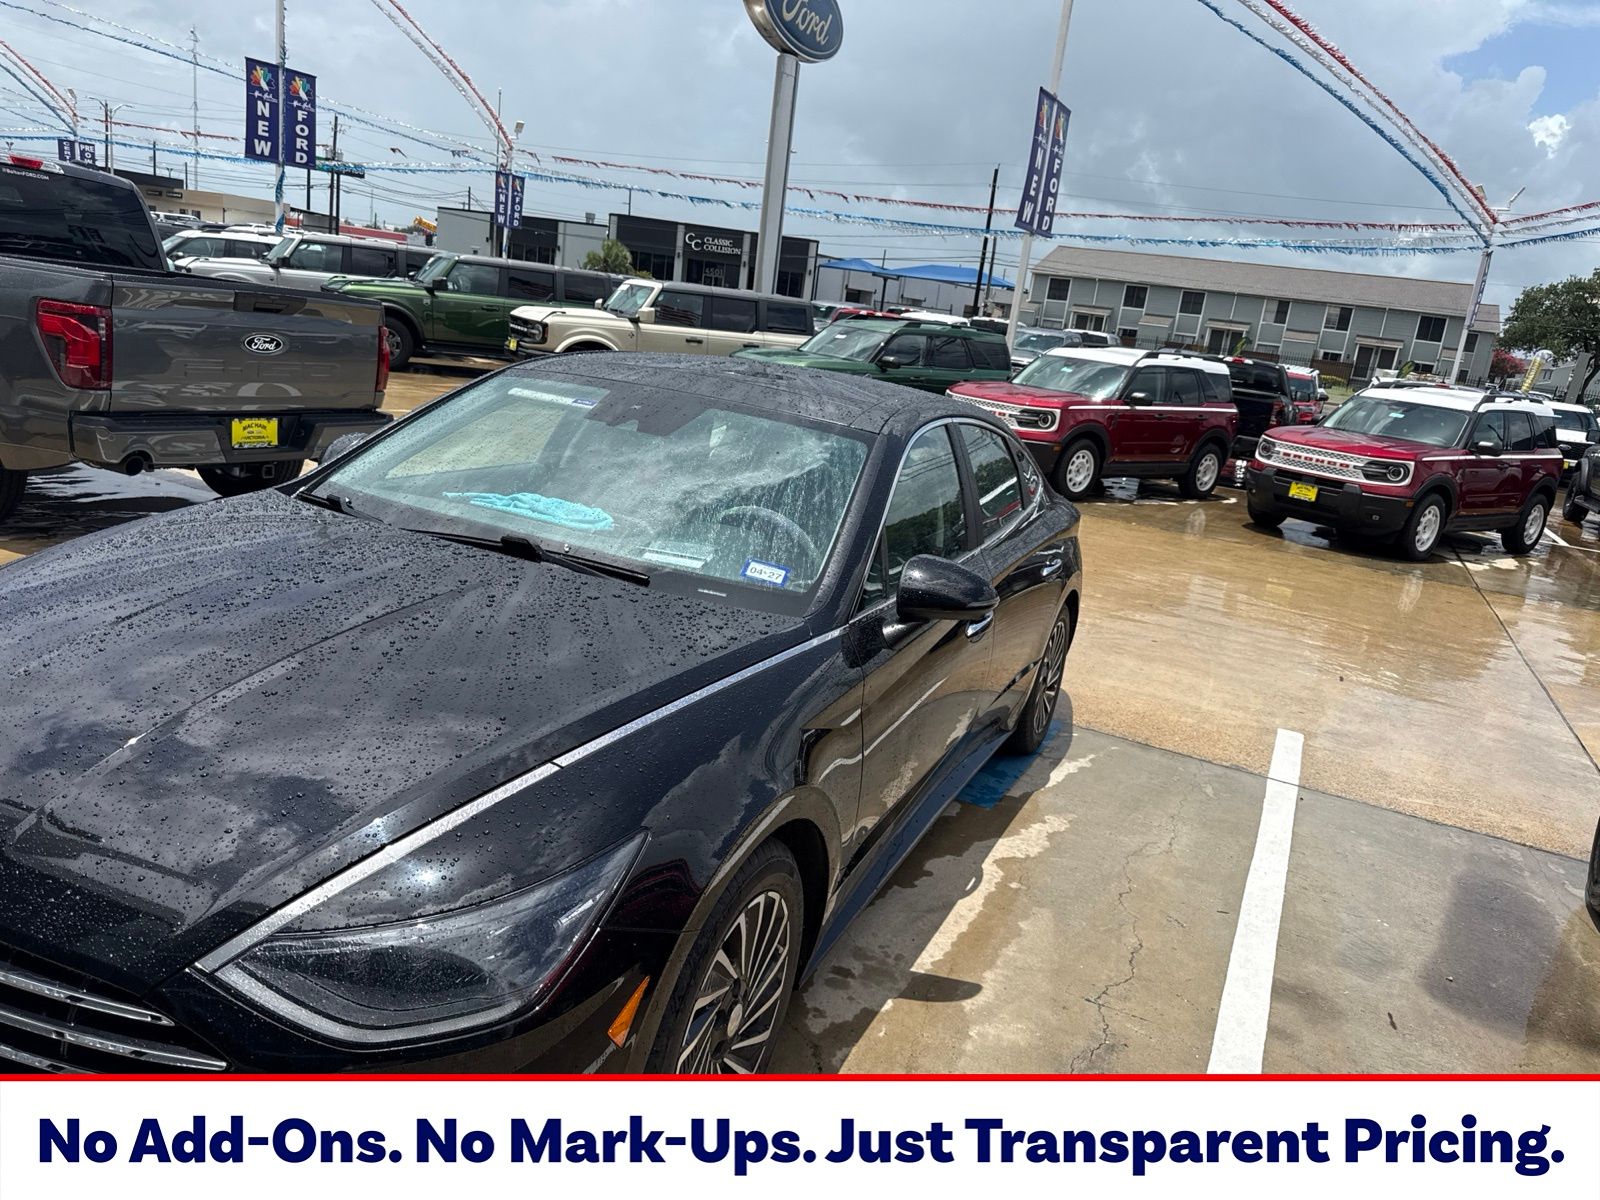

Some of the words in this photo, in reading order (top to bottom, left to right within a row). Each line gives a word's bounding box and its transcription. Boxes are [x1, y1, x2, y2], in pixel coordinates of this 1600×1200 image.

[254, 100, 272, 156] NEW
[295, 109, 309, 164] FORD
[1022, 147, 1043, 223] NEW
[1041, 158, 1060, 231] FORD
[497, 193, 506, 224] NEW
[513, 196, 521, 227] FORD
[703, 236, 733, 247] CLASSIC
[703, 243, 742, 255] COLLISION
[251, 336, 277, 350] Ford
[1282, 451, 1350, 469] BRONCO
